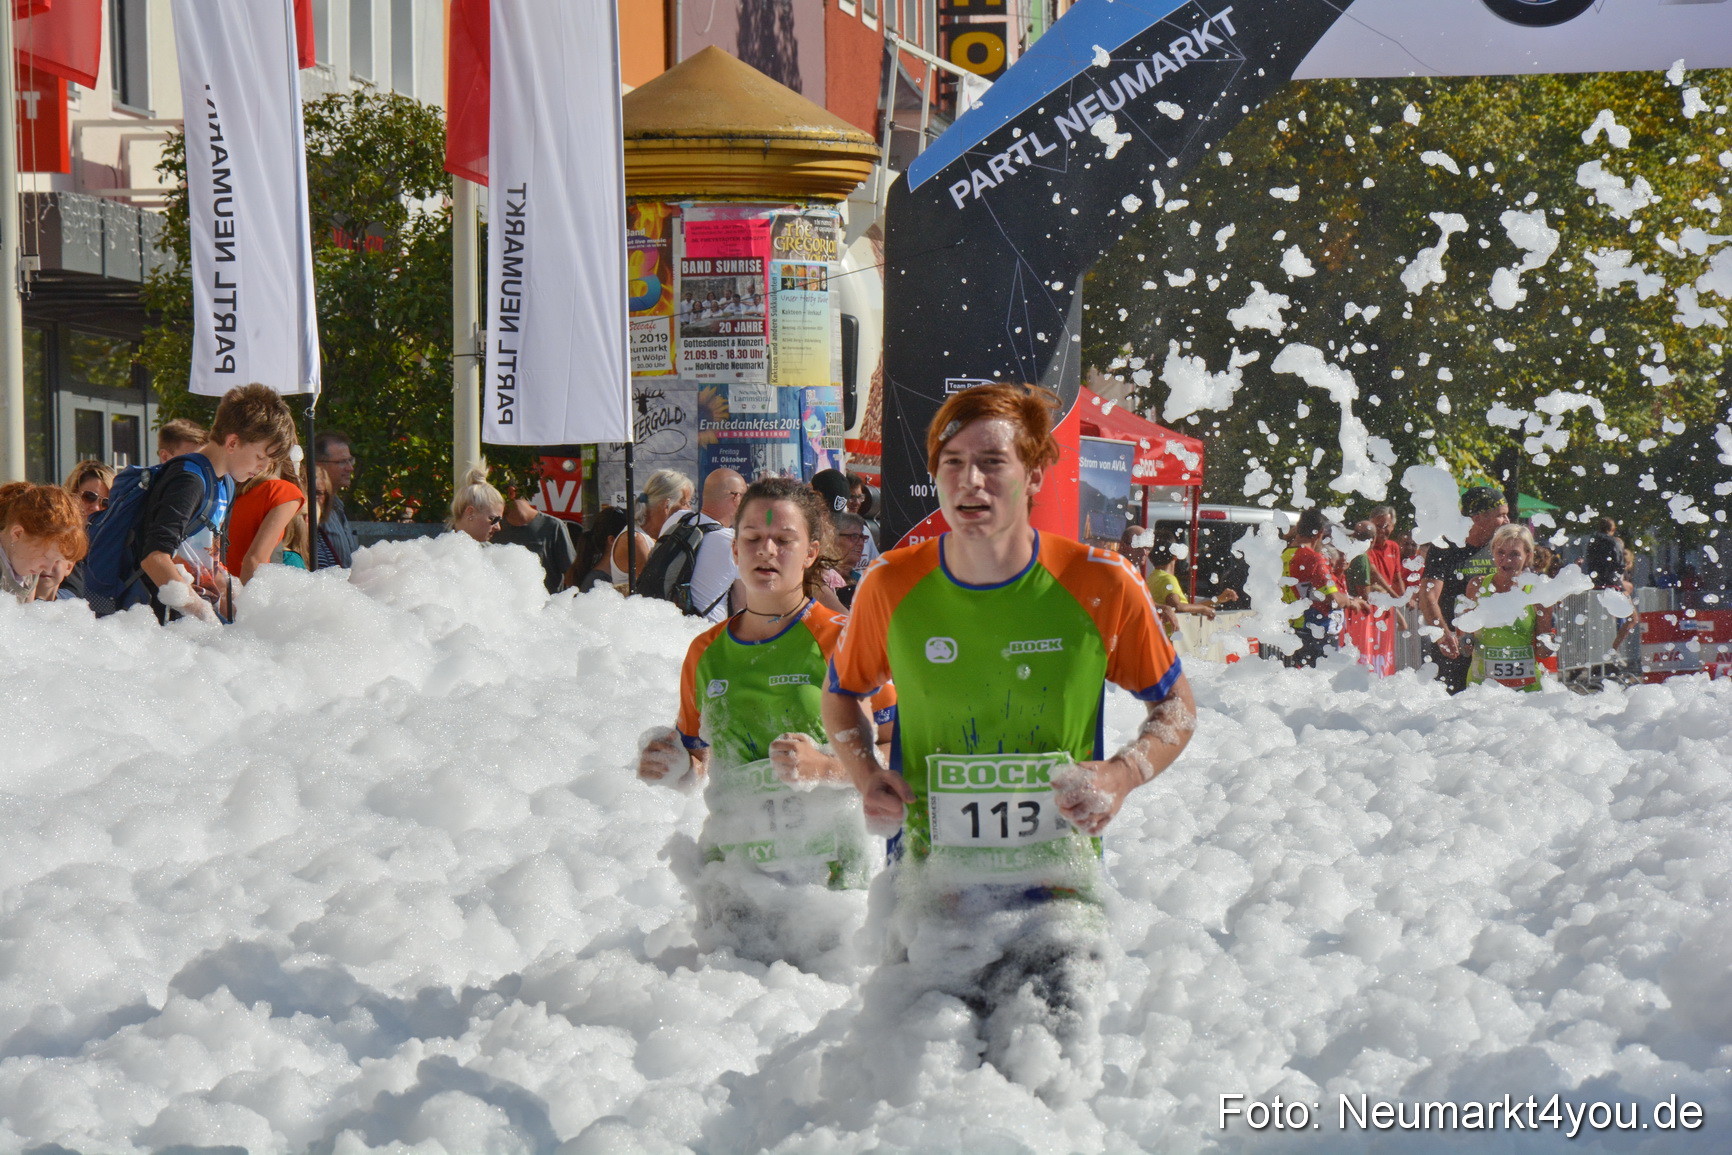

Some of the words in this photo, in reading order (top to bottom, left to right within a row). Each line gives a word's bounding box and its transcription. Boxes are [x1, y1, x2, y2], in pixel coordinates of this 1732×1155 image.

[949, 131, 1058, 210] PARTL
[1054, 6, 1237, 141] NEUMARKT
[682, 260, 711, 274] BAND
[716, 259, 762, 273] SUNRISE
[719, 321, 729, 333] 20
[734, 321, 764, 333] JAHRE
[640, 333, 668, 343] 2019
[683, 340, 729, 348] Gottesdienst
[738, 339, 764, 347] Konzert
[684, 350, 718, 360] 21.09.19
[726, 350, 747, 360] 18.30
[750, 349, 764, 359] Uhr
[695, 361, 729, 371] Hofkirche
[731, 361, 764, 370] Neumarkt
[700, 419, 778, 431] Erntedankfest
[779, 419, 801, 430] 2019
[1079, 456, 1098, 468] Strom
[1099, 459, 1111, 469] von
[909, 484, 927, 497] 100
[1009, 638, 1063, 655] BOCK
[1494, 663, 1524, 677] 535
[768, 674, 811, 687] BOCK
[938, 760, 1055, 789] BOCK
[961, 800, 1041, 839] 113
